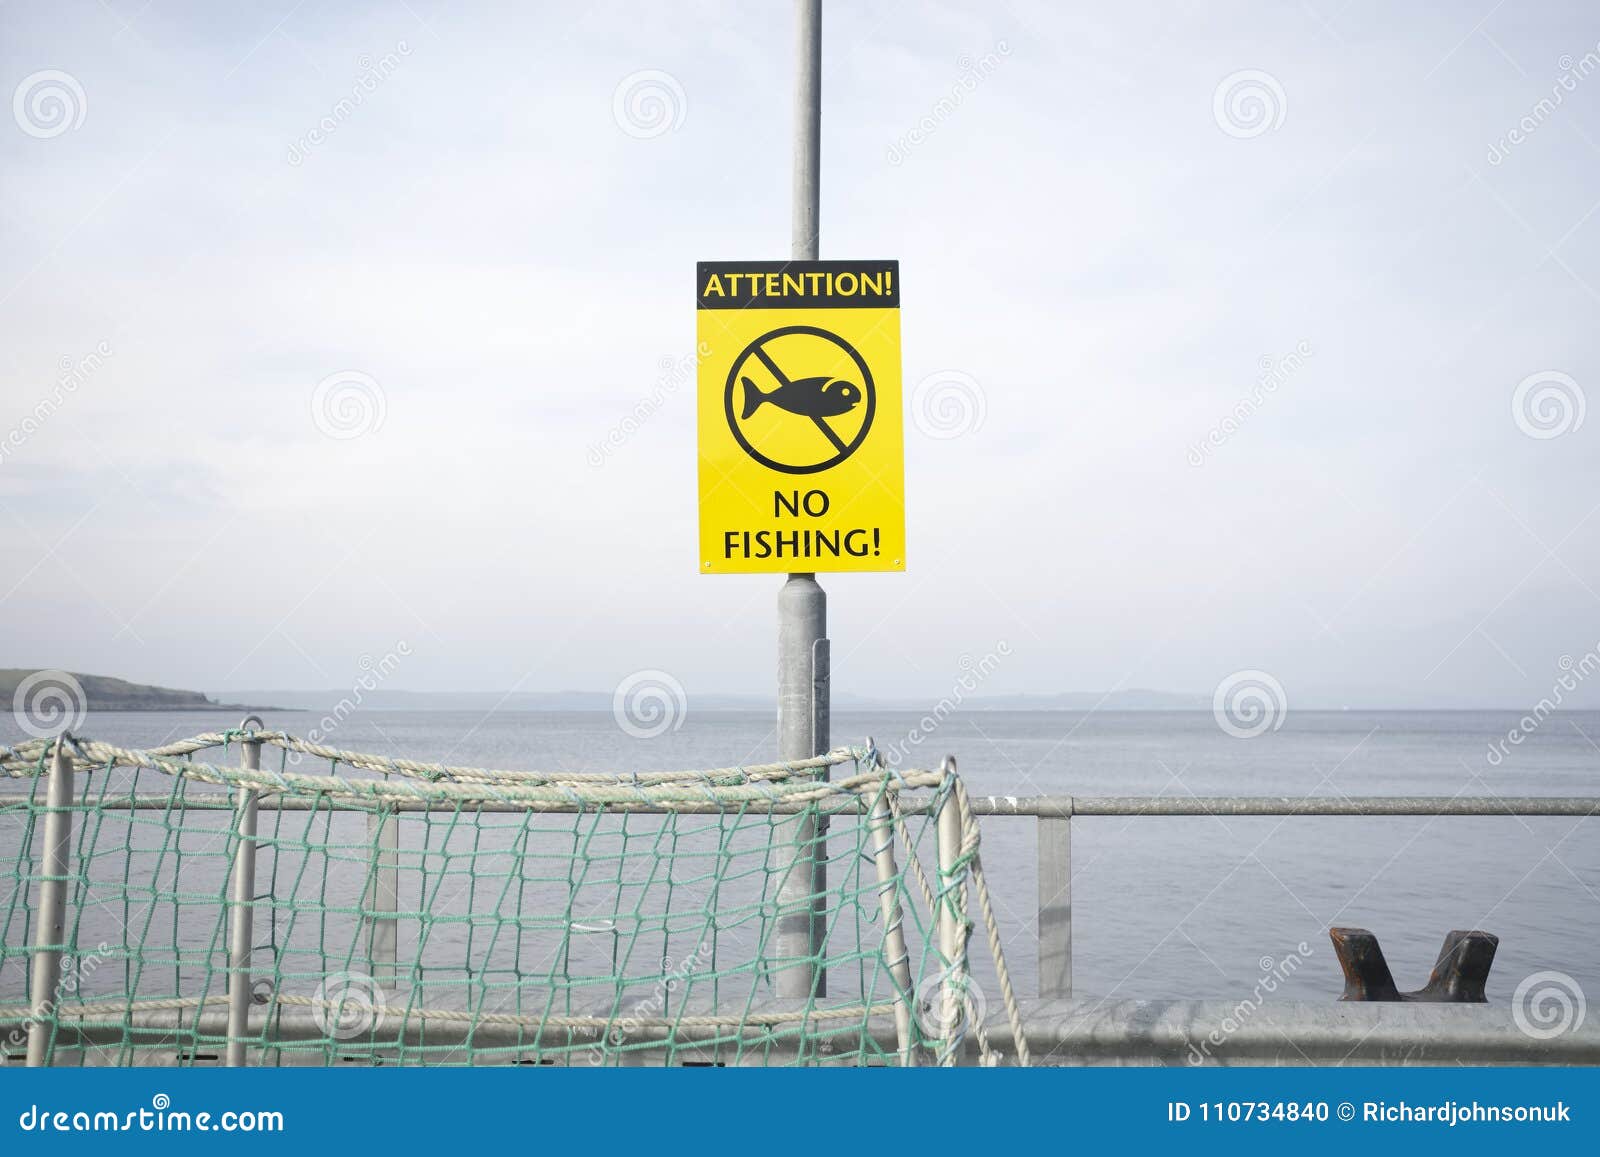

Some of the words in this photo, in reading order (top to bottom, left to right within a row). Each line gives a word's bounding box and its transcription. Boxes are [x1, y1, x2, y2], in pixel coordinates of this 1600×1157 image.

[703, 271, 893, 298] ATTENTION!
[774, 489, 830, 518] NO
[724, 527, 881, 559] FISHING!
